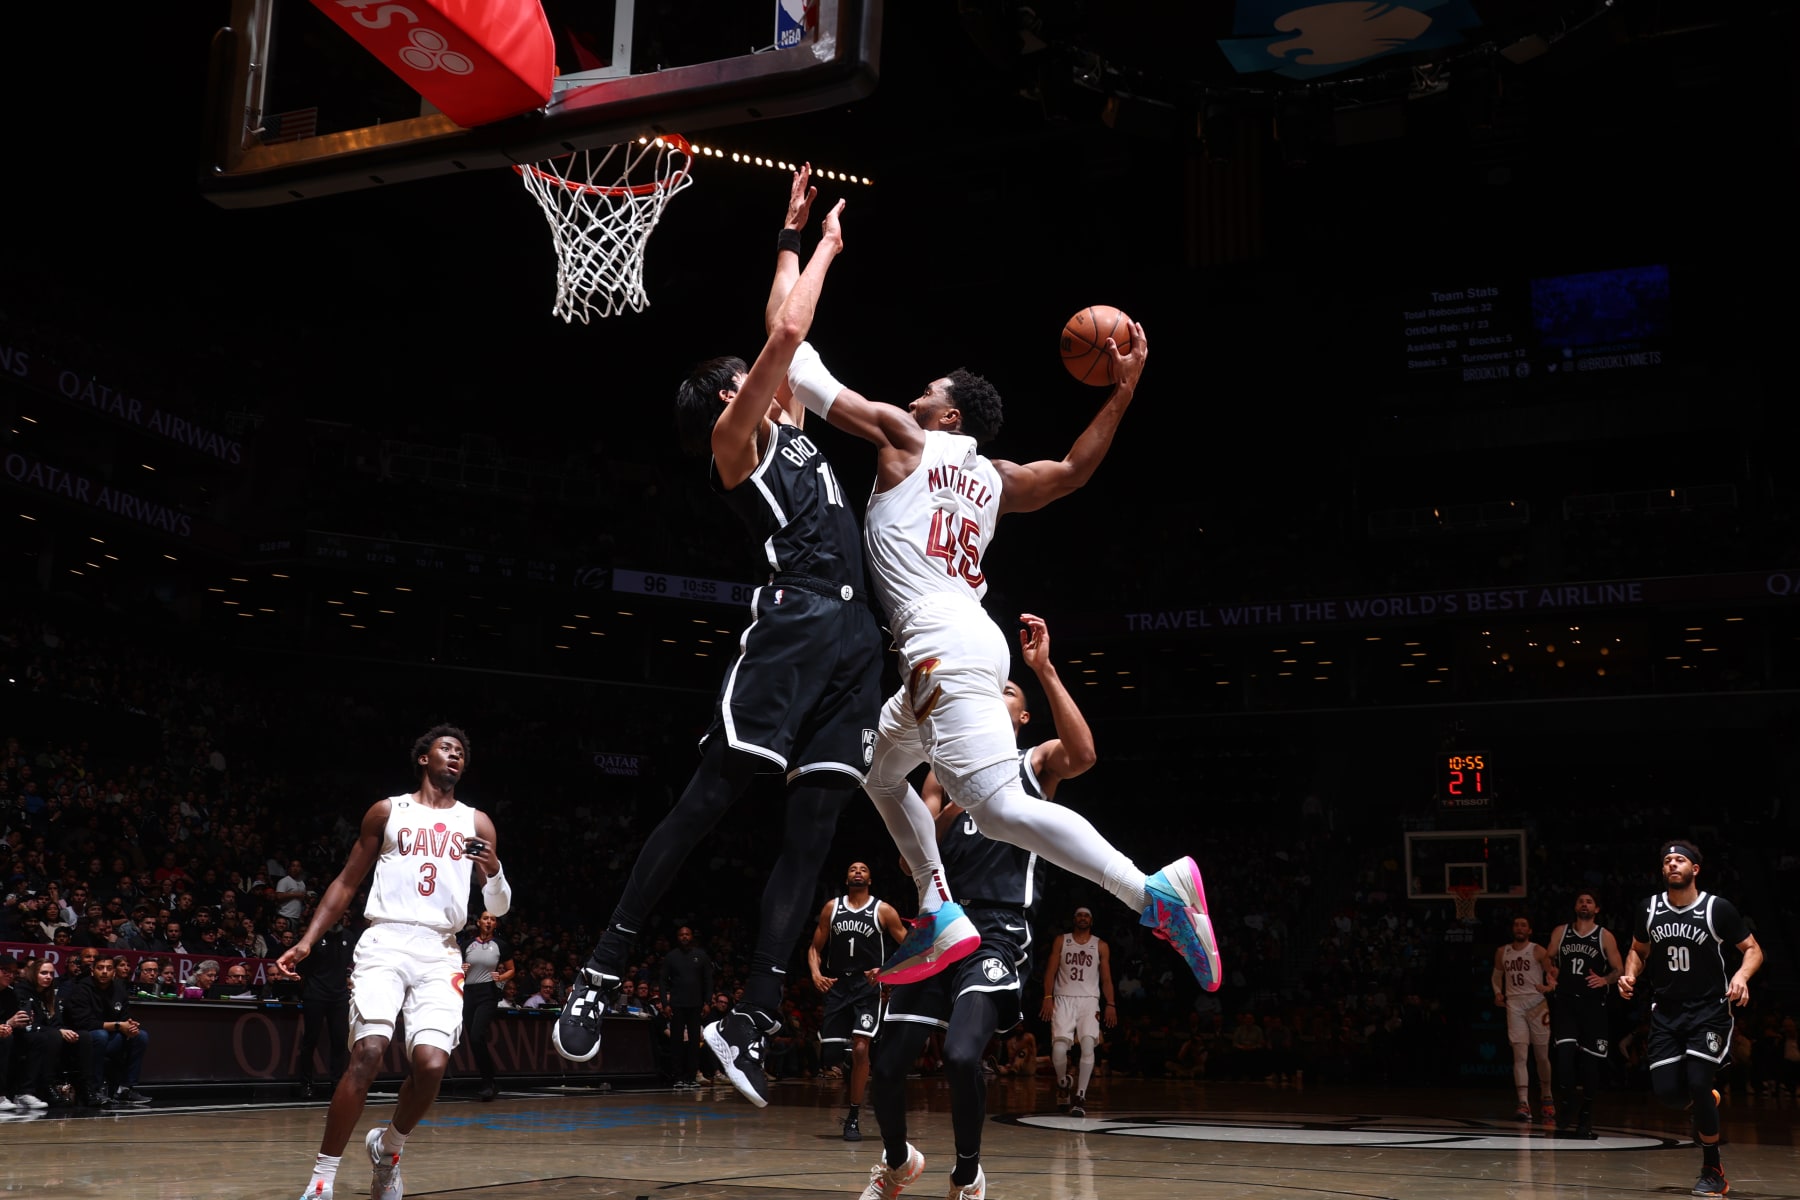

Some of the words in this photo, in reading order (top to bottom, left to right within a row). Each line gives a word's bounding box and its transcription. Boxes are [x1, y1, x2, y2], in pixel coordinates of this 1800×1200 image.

[781, 28, 801, 46] NBA
[1431, 290, 1464, 303] Team
[1466, 287, 1499, 300] Stats
[1402, 310, 1426, 320] Total
[57, 369, 143, 425] QATAR
[147, 408, 242, 465] AIRWAYS
[5, 452, 91, 503] QATAR
[95, 485, 193, 537] AIRWAYS
[816, 462, 844, 508] 1
[926, 507, 986, 590] 45
[643, 575, 667, 594] 96
[682, 578, 717, 595] 10:55
[1124, 608, 1213, 633] TRAVEL
[1218, 604, 1283, 627] WITH
[1289, 600, 1338, 622] THE
[1344, 593, 1459, 619] WORLD'S
[1466, 588, 1529, 613] BEST
[1537, 581, 1644, 609] AIRLINE
[593, 754, 639, 769] QATAR
[1448, 755, 1485, 770] 10:55
[1448, 771, 1483, 795] 21
[397, 827, 465, 861] CAVS
[418, 862, 437, 897] 3
[833, 919, 875, 938] BROOKLYN
[1650, 922, 1709, 946] BROOKLYN
[848, 937, 855, 957] 1
[1561, 943, 1600, 959] BROOKLYN
[1065, 951, 1093, 968] CAVS
[1504, 959, 1530, 972] CAVS
[1571, 957, 1585, 976] 12
[1667, 945, 1691, 972] 30
[1070, 967, 1084, 982] 31
[1511, 973, 1525, 986] 16
